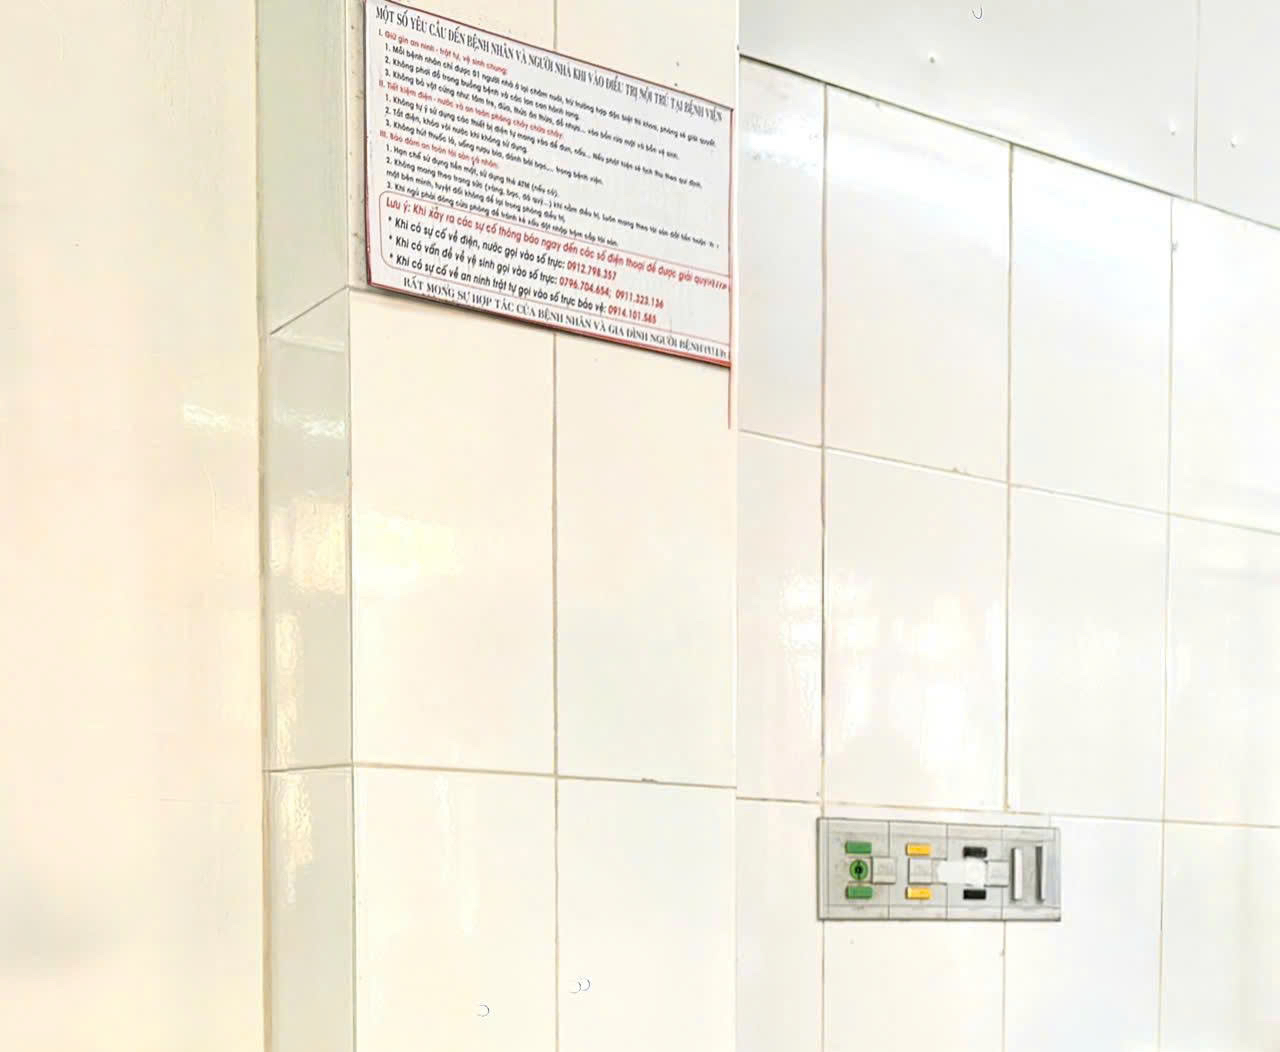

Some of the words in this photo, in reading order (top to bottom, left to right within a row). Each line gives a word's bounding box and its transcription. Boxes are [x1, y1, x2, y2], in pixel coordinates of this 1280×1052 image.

[375, 2, 393, 26] MỘT
[396, 9, 407, 27] SỐ
[410, 13, 426, 33] YÊU
[429, 19, 446, 39] CẦU
[448, 25, 464, 45] ĐẾN
[467, 31, 488, 55] BỆNH
[491, 38, 512, 60] NHÂN
[515, 46, 526, 64] VÀ
[529, 50, 552, 72] NGƯỜI
[573, 67, 585, 82] KHI
[588, 68, 603, 87] VÀO
[406, 48, 422, 63] bệnh
[392, 57, 413, 72] Không
[392, 70, 413, 85] Không
[393, 95, 413, 110] Không
[393, 120, 414, 134] Không
[394, 158, 414, 172] Không
[386, 197, 400, 209] Lưu
[413, 203, 425, 215] Khi
[446, 214, 453, 222] ra
[456, 213, 472, 227] các
[475, 221, 483, 232] sự
[486, 220, 496, 233] cố
[498, 223, 521, 242] thông
[523, 229, 538, 243] báo
[541, 238, 560, 251] ngay
[563, 239, 577, 253] đến
[580, 243, 593, 257] các
[597, 248, 606, 260] số
[607, 250, 623, 267] điện
[395, 217, 407, 229] Khi
[410, 220, 421, 233] có
[424, 227, 433, 238] sự
[435, 226, 446, 239] cố
[448, 229, 457, 241] về
[460, 232, 479, 250] điện,
[482, 237, 501, 252] nước
[505, 244, 517, 259] gọi
[520, 246, 534, 260] vào
[537, 250, 546, 263] số
[395, 235, 408, 248] Khi
[411, 237, 422, 251] có
[424, 240, 439, 255] vấn
[442, 245, 452, 258] đề
[455, 248, 464, 261] về
[467, 251, 476, 267] vệ
[479, 255, 494, 268] sinh
[496, 259, 509, 275] gọi
[512, 261, 526, 276] vào
[529, 265, 538, 279] số
[396, 253, 409, 266] Khi
[411, 256, 422, 269] có
[424, 263, 434, 276] sự
[436, 262, 447, 275] cố
[449, 265, 458, 278] về
[460, 271, 470, 281] an
[473, 271, 490, 285] ninh
[492, 275, 506, 292] trật
[508, 280, 516, 294] tự
[518, 282, 530, 298] gọi
[533, 284, 547, 298] vào
[550, 288, 560, 301] số
[403, 273, 423, 290] RẤT
[426, 282, 454, 297] MONG
[538, 304, 562, 324] BỆNH
[565, 310, 590, 327] NHÂN
[593, 317, 605, 331] VÀ
[608, 323, 623, 335] GIA
